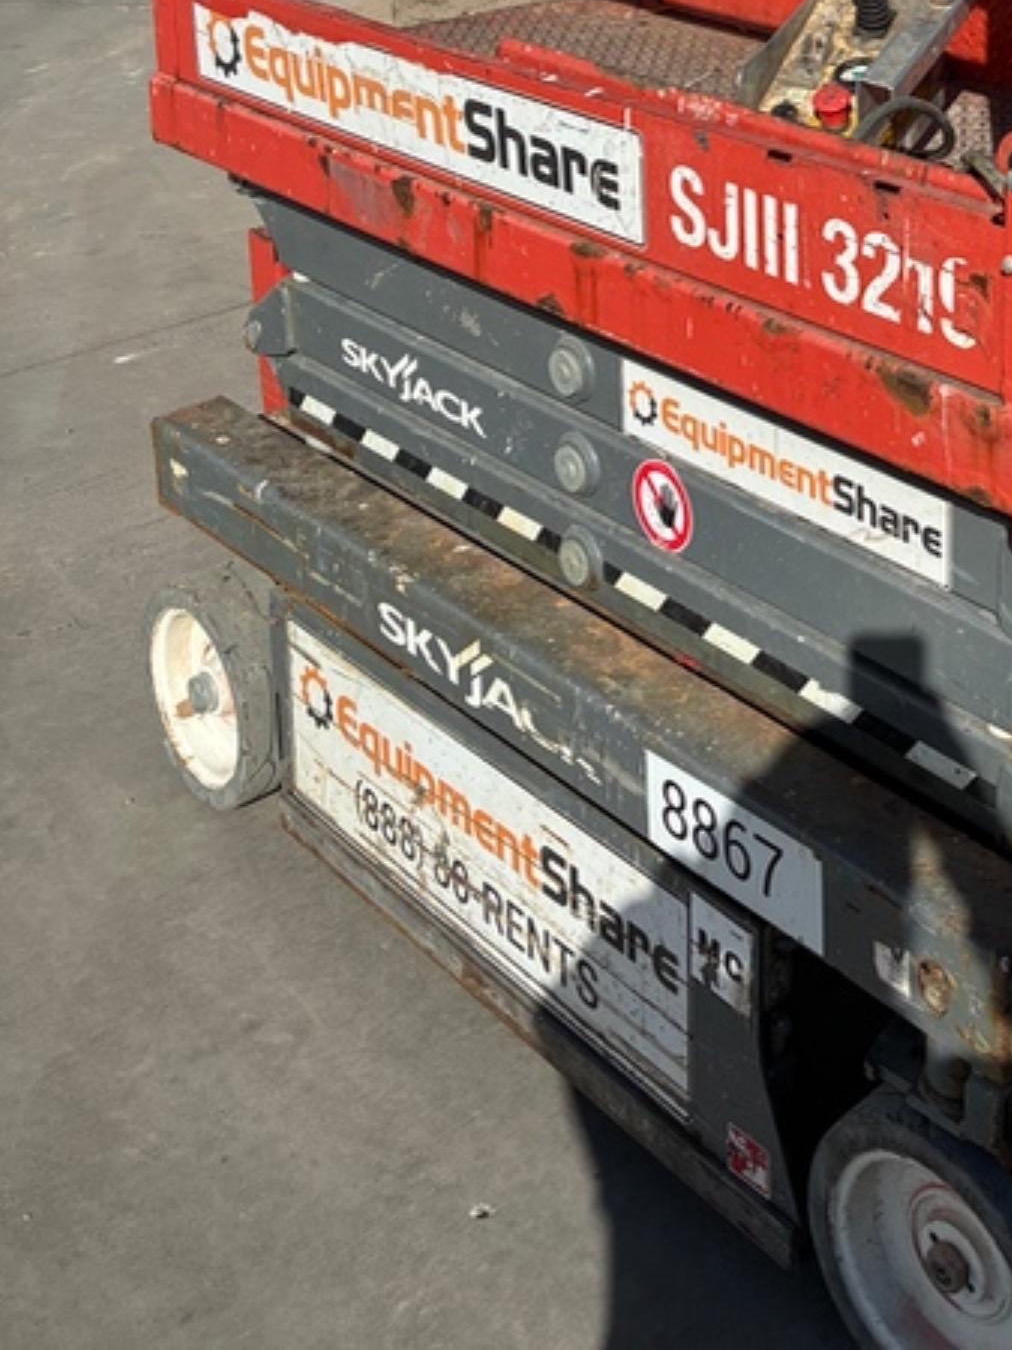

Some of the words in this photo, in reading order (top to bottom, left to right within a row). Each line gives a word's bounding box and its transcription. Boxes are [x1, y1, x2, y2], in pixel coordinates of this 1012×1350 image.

[243, 25, 620, 210] EquipmentShare
[340, 337, 488, 439] SKYJACK
[661, 397, 942, 559] EquipmentShare
[377, 602, 602, 787] SKYJA
[335, 694, 681, 996] EquipmentShare
[355, 779, 424, 871] (888)
[662, 779, 785, 898] 8867
